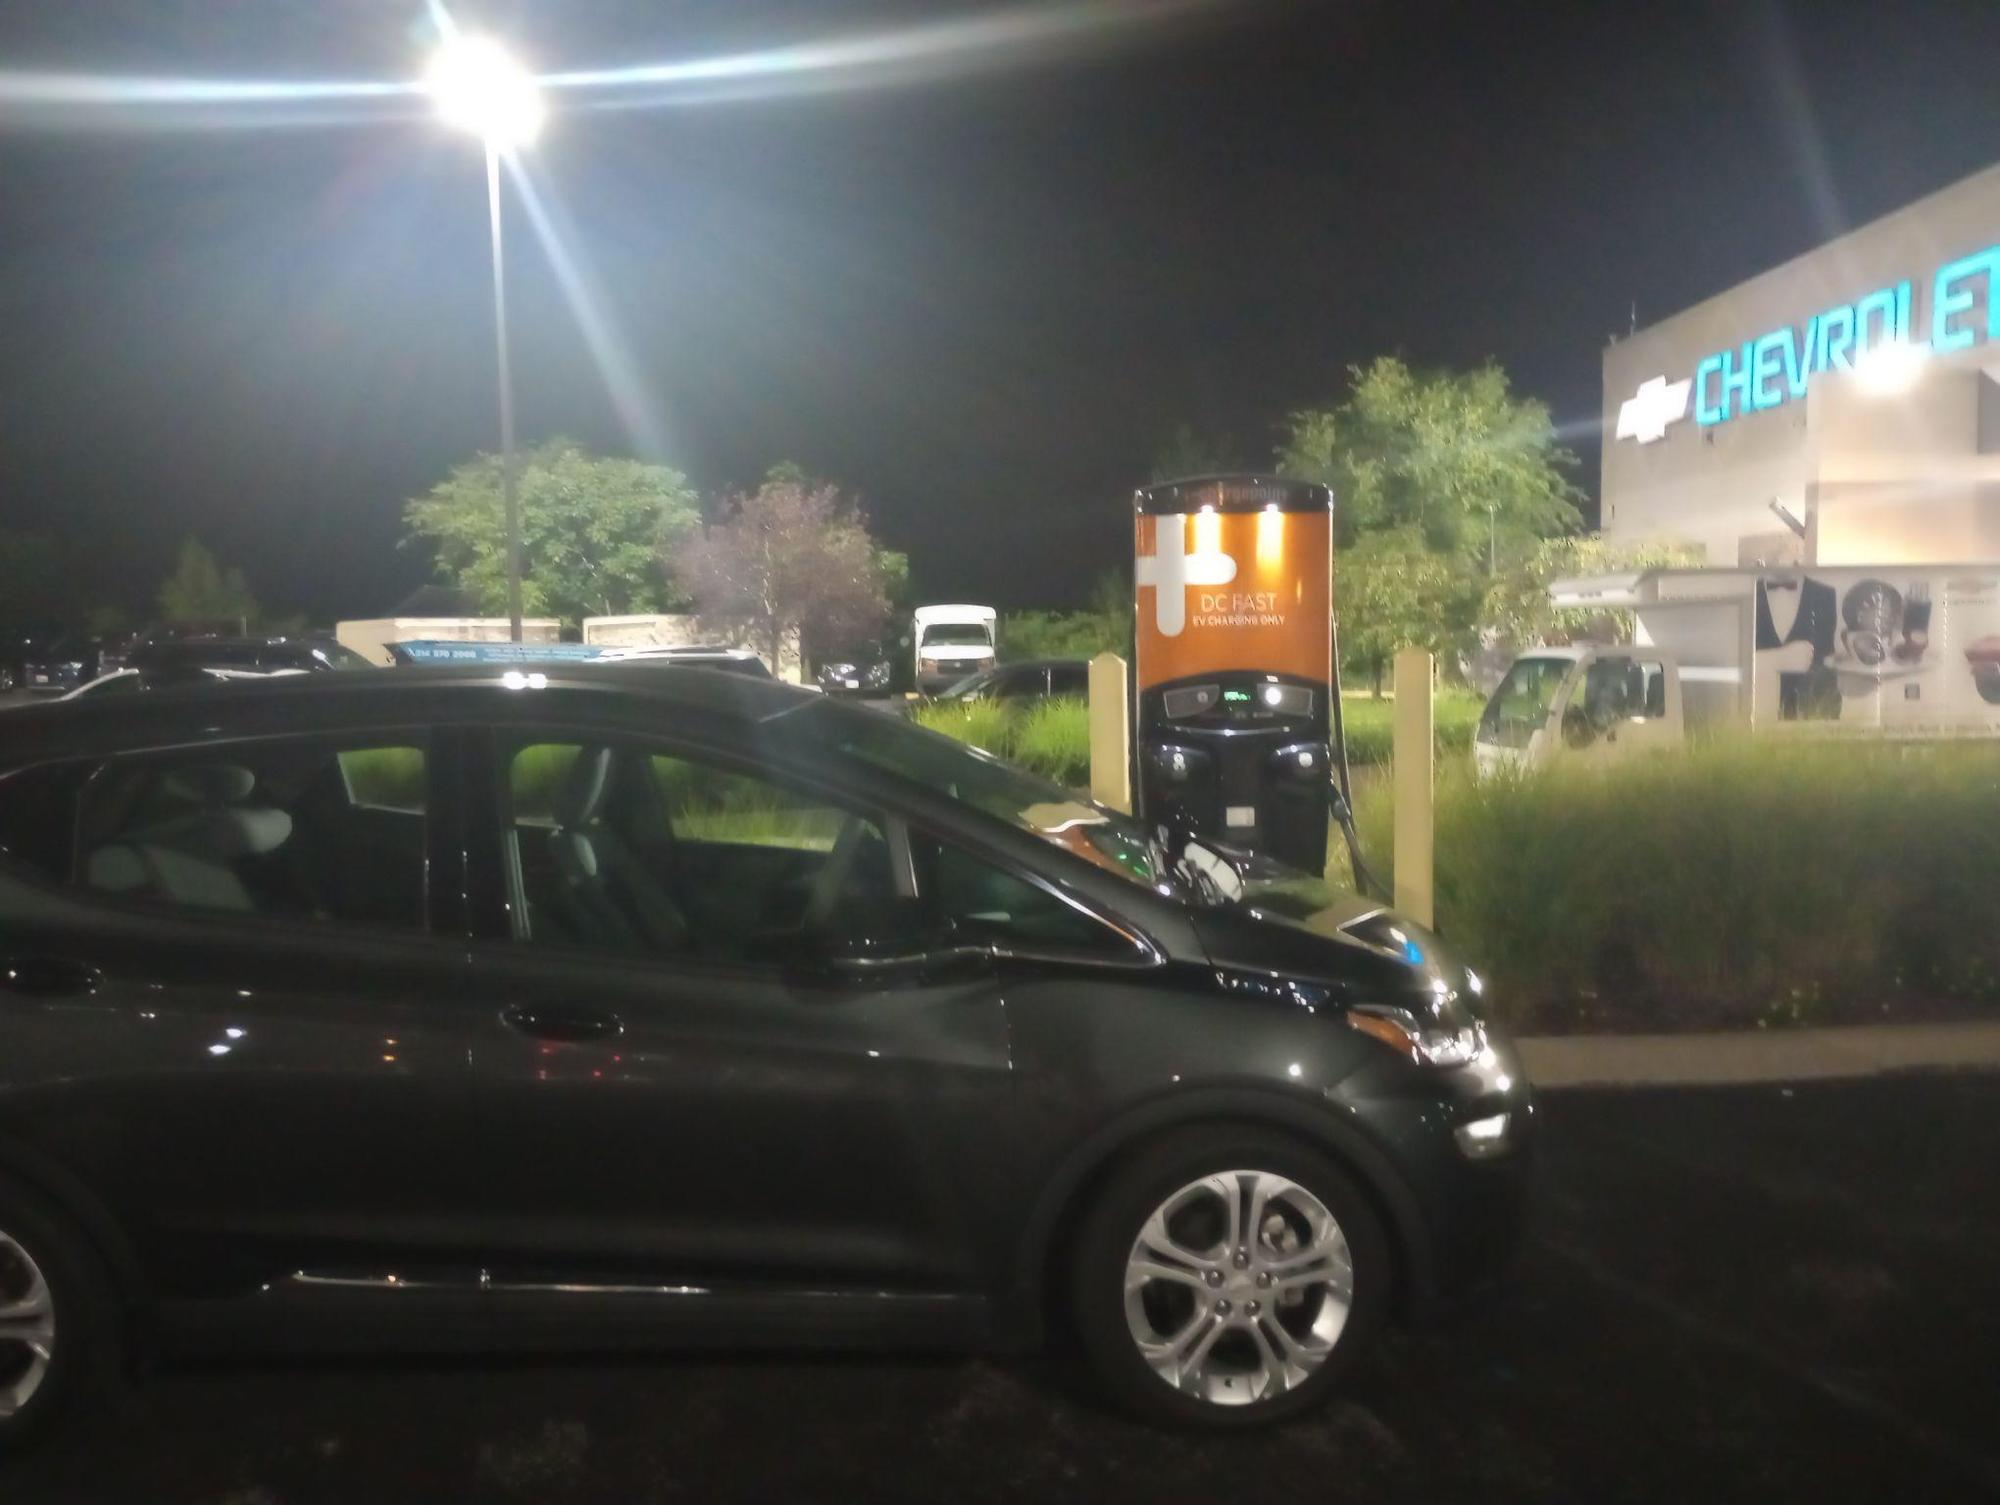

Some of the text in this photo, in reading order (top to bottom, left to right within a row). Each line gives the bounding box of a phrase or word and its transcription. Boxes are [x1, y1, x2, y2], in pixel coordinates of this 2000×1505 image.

[1695, 244, 2000, 426] CHEVROLET
[1200, 592, 1277, 612] DC FAST
[1192, 614, 1285, 626] EV CHARGING ONLY
